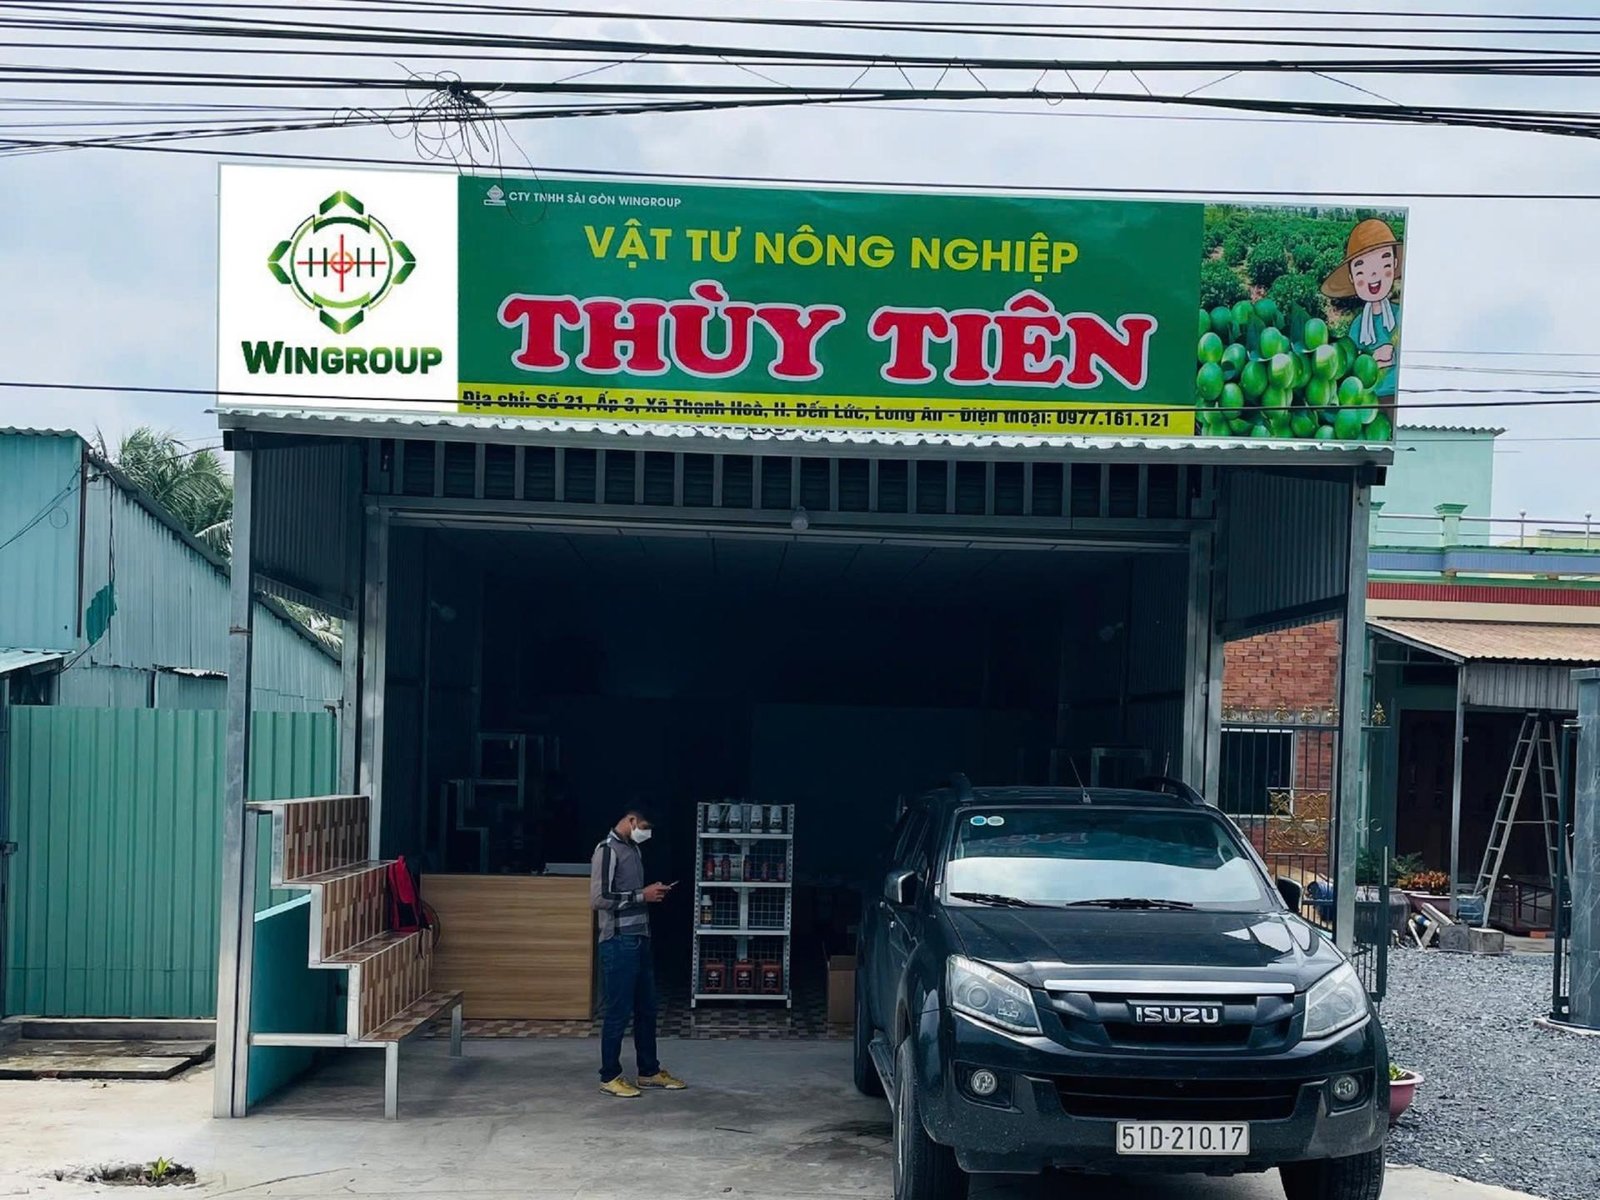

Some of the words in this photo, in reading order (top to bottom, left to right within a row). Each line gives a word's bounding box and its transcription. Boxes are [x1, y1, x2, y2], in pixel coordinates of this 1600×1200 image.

[509, 191, 530, 201] CTY
[534, 192, 565, 204] TNHH
[567, 192, 586, 204] SÀI
[589, 193, 615, 206] GÒN
[618, 195, 682, 208] WINGROUP
[584, 218, 672, 269] VẬT
[686, 226, 742, 263] TƯ
[755, 224, 895, 269] NÔNG
[911, 232, 1079, 283] NGHIỆP
[498, 279, 846, 382] THÙY
[867, 289, 1157, 391] TIÊN
[463, 390, 492, 410] Địa
[498, 390, 530, 408] chỉ:
[536, 392, 559, 409] Số
[564, 395, 590, 412] 21,
[646, 397, 668, 413] Xã
[673, 398, 726, 418] Thạnh
[774, 402, 791, 417] H.
[796, 400, 829, 418] Bến
[1056, 410, 1170, 427] 0977.161.121
[1136, 1007, 1219, 1023] ISUZU
[1122, 1126, 1244, 1150] 51D-210.17
